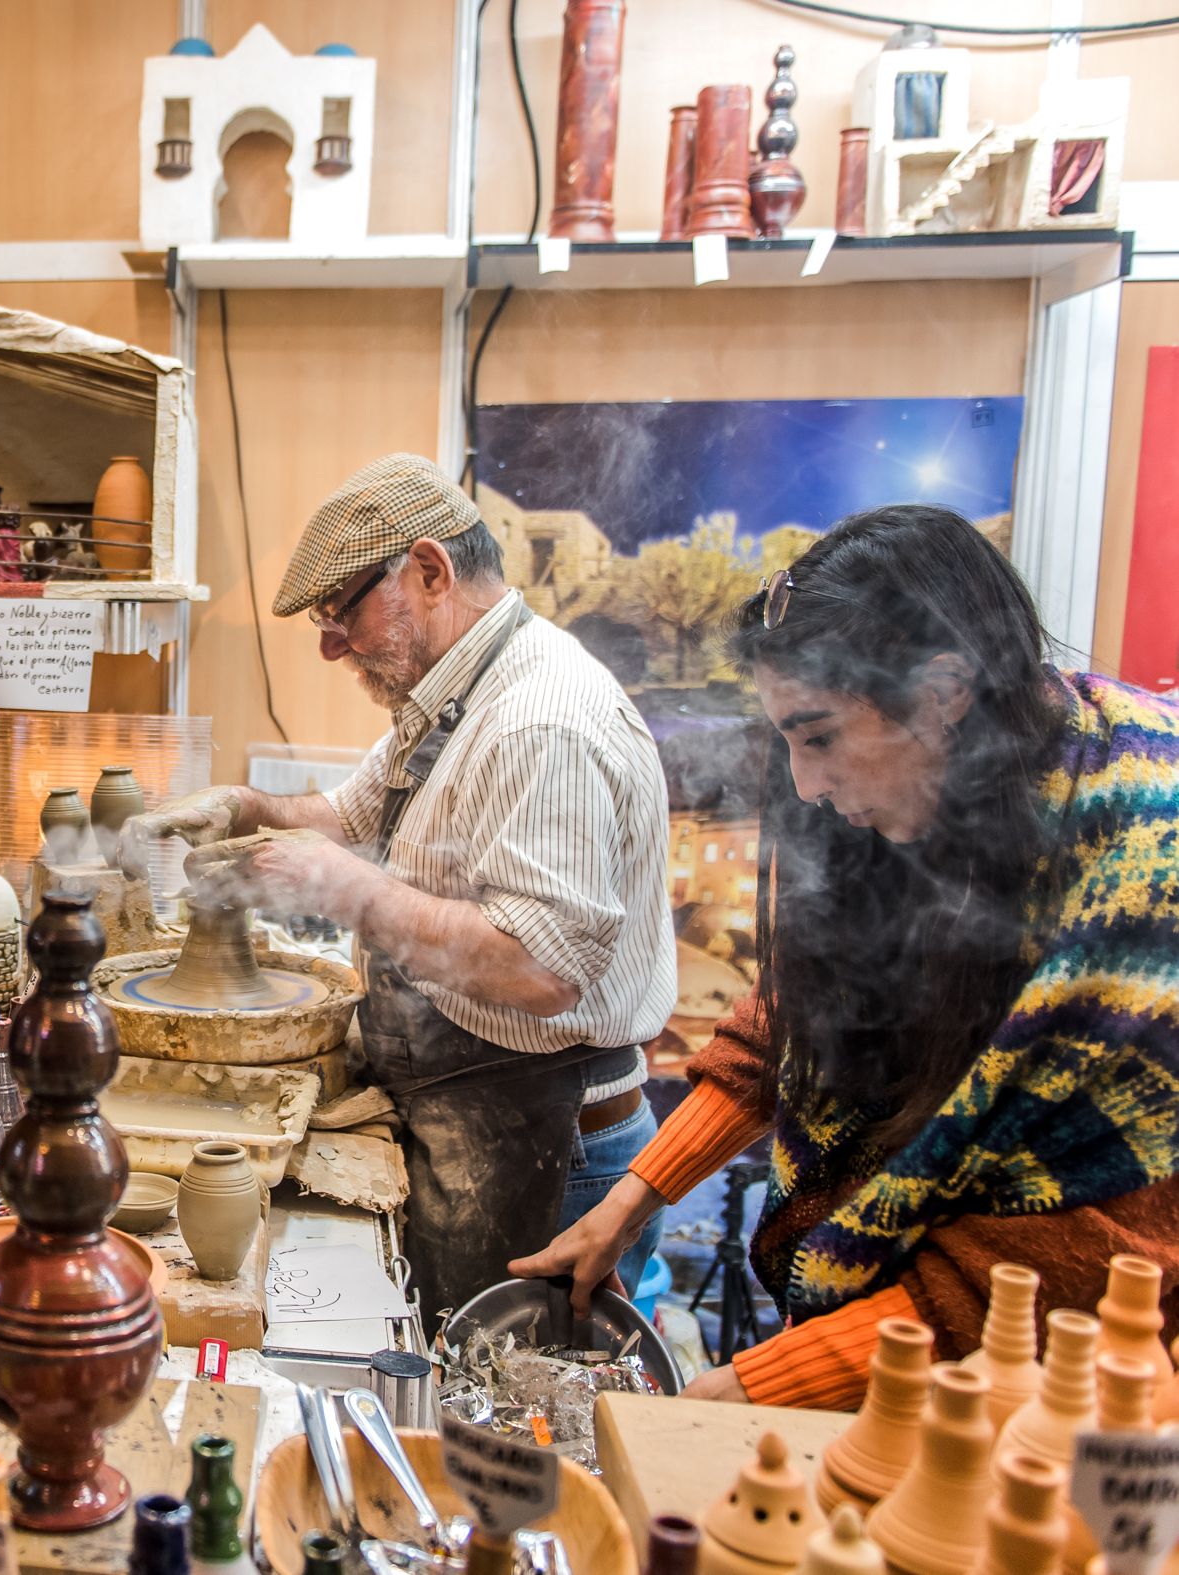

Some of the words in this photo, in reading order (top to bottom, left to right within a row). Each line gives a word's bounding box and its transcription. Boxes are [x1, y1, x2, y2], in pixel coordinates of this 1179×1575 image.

[10, 605, 41, 618] Noble
[50, 606, 91, 619] bizarro
[7, 627, 35, 637] todos
[40, 624, 49, 636] el
[52, 625, 92, 641] primero
[7, 640, 20, 651] las
[23, 640, 45, 651] artes
[48, 640, 61, 651] del
[64, 641, 91, 651] barro
[37, 685, 85, 695] Cacharro
